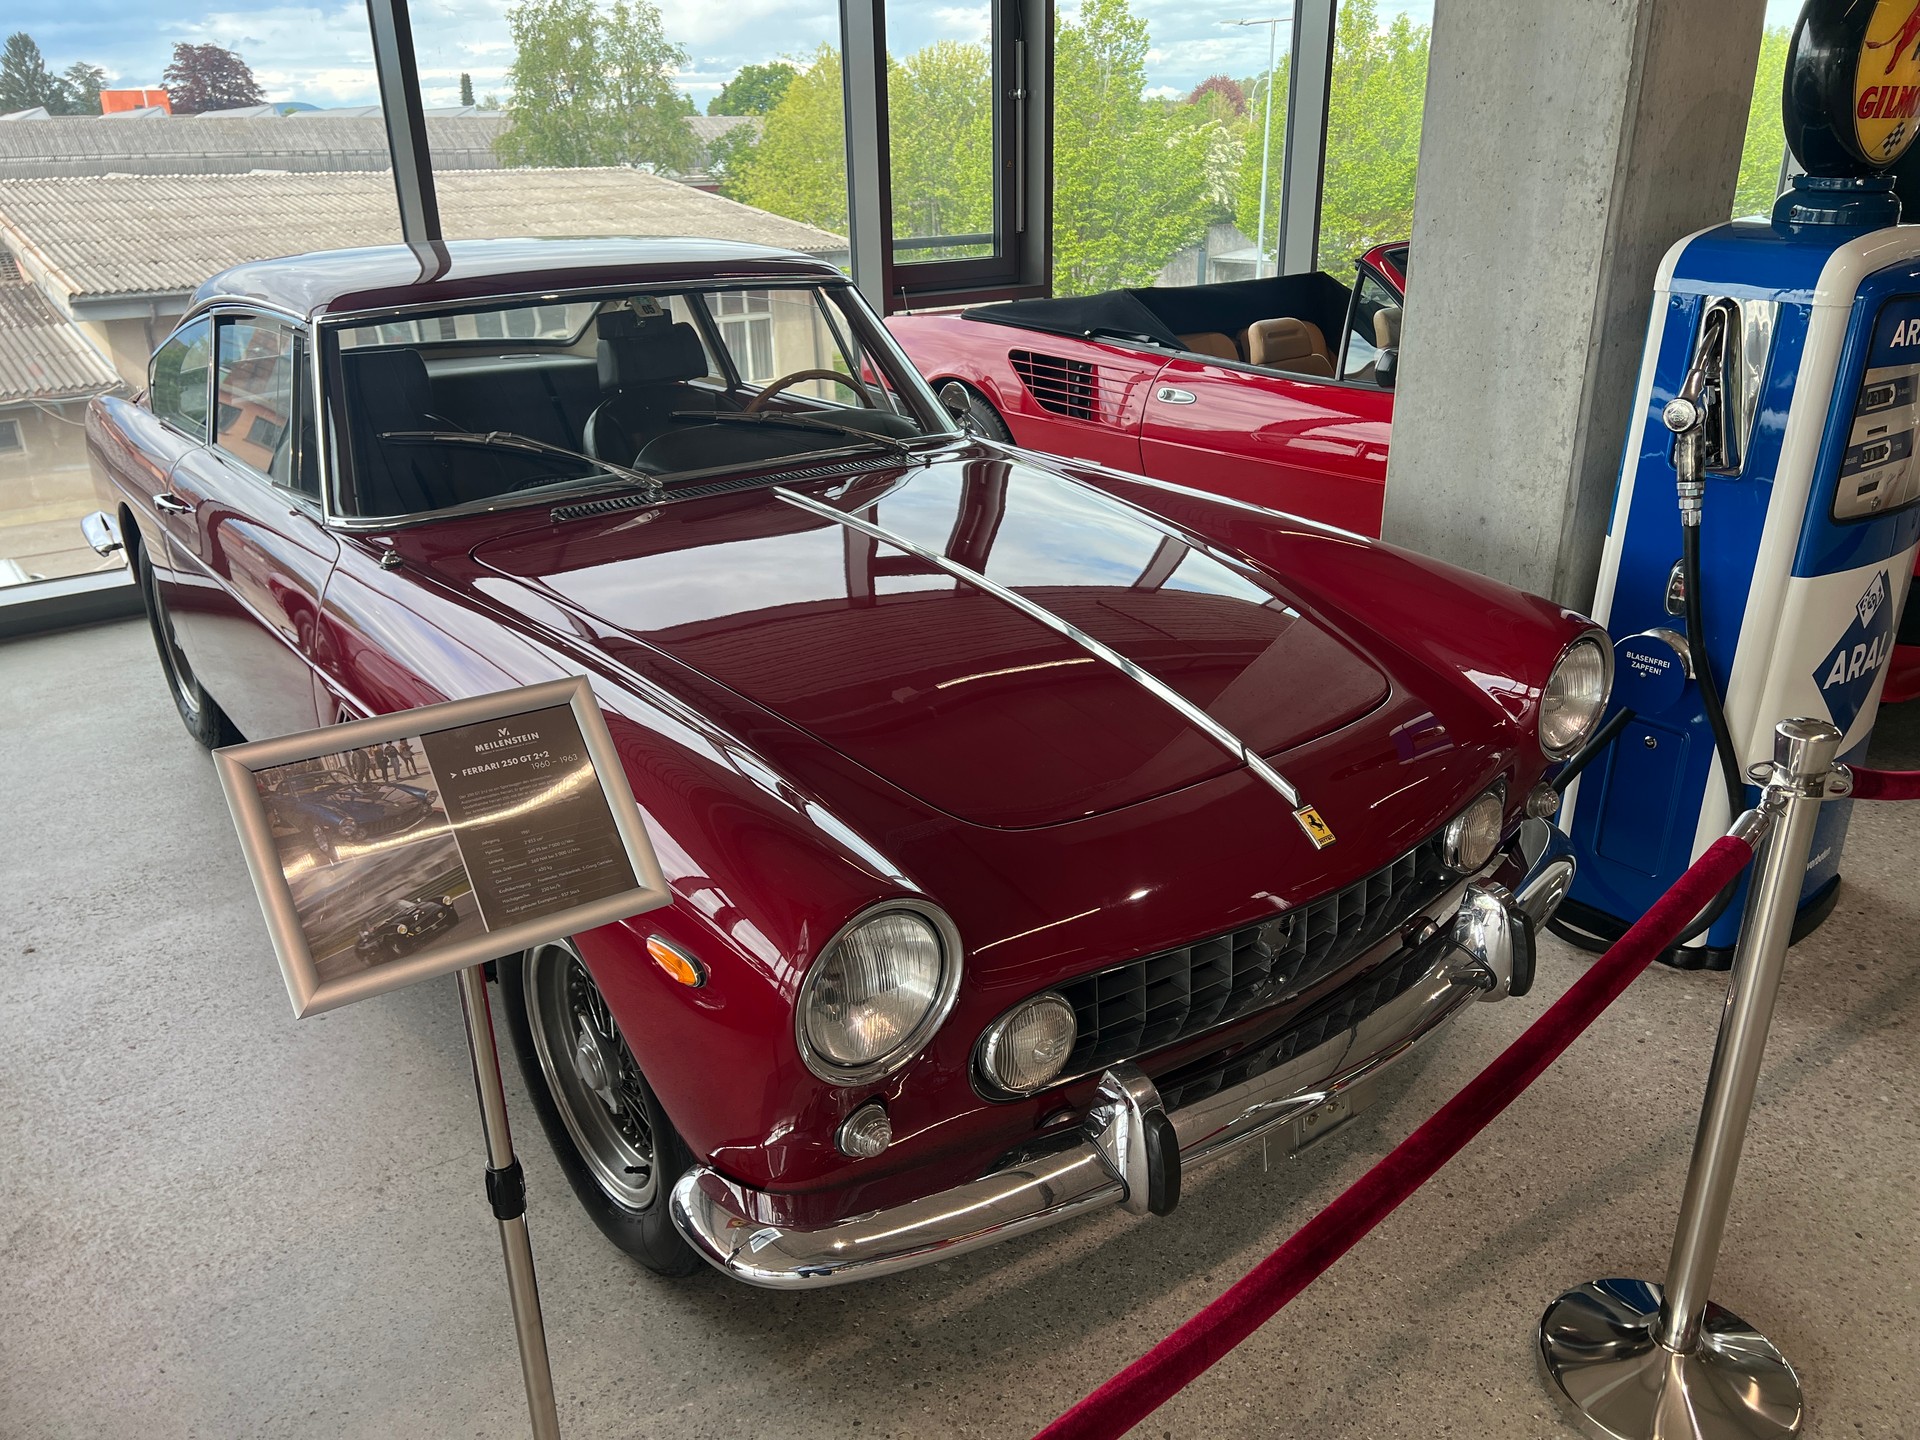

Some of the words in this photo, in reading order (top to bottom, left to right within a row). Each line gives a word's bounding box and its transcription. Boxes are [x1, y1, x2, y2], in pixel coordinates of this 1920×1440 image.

[1890, 318, 1920, 348] AR
[1626, 651, 1671, 669] BLASENFREI
[1631, 660, 1662, 676] ZAPFEN!
[1823, 631, 1887, 690] ARAL
[475, 732, 540, 752] MEILENSTEIN
[462, 762, 500, 777] FERRARI
[501, 758, 519, 767] 250
[520, 755, 533, 763] GT
[533, 751, 550, 760] 2+2
[531, 760, 551, 770] 1960
[560, 754, 578, 764] 1963
